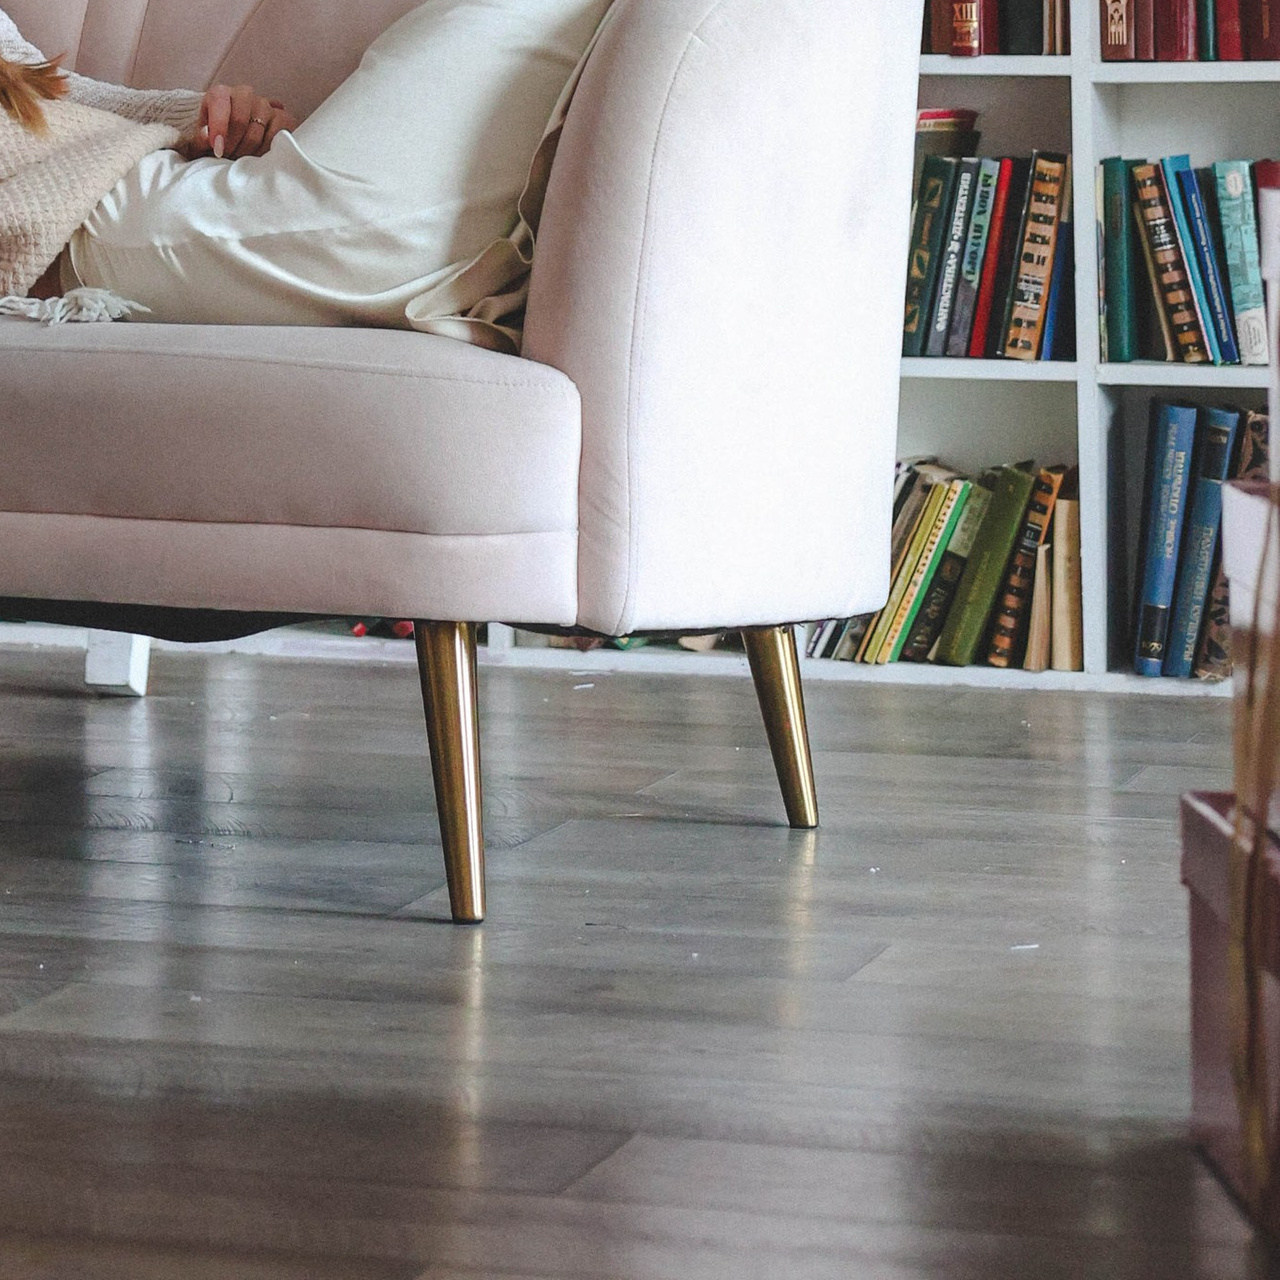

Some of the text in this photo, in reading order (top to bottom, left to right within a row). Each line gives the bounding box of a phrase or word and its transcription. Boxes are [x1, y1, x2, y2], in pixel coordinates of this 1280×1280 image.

[954, 3, 976, 22] XIII
[935, 257, 957, 332] ФАНТАСТИКА
[951, 171, 971, 236] ДЕТЕКТИВ
